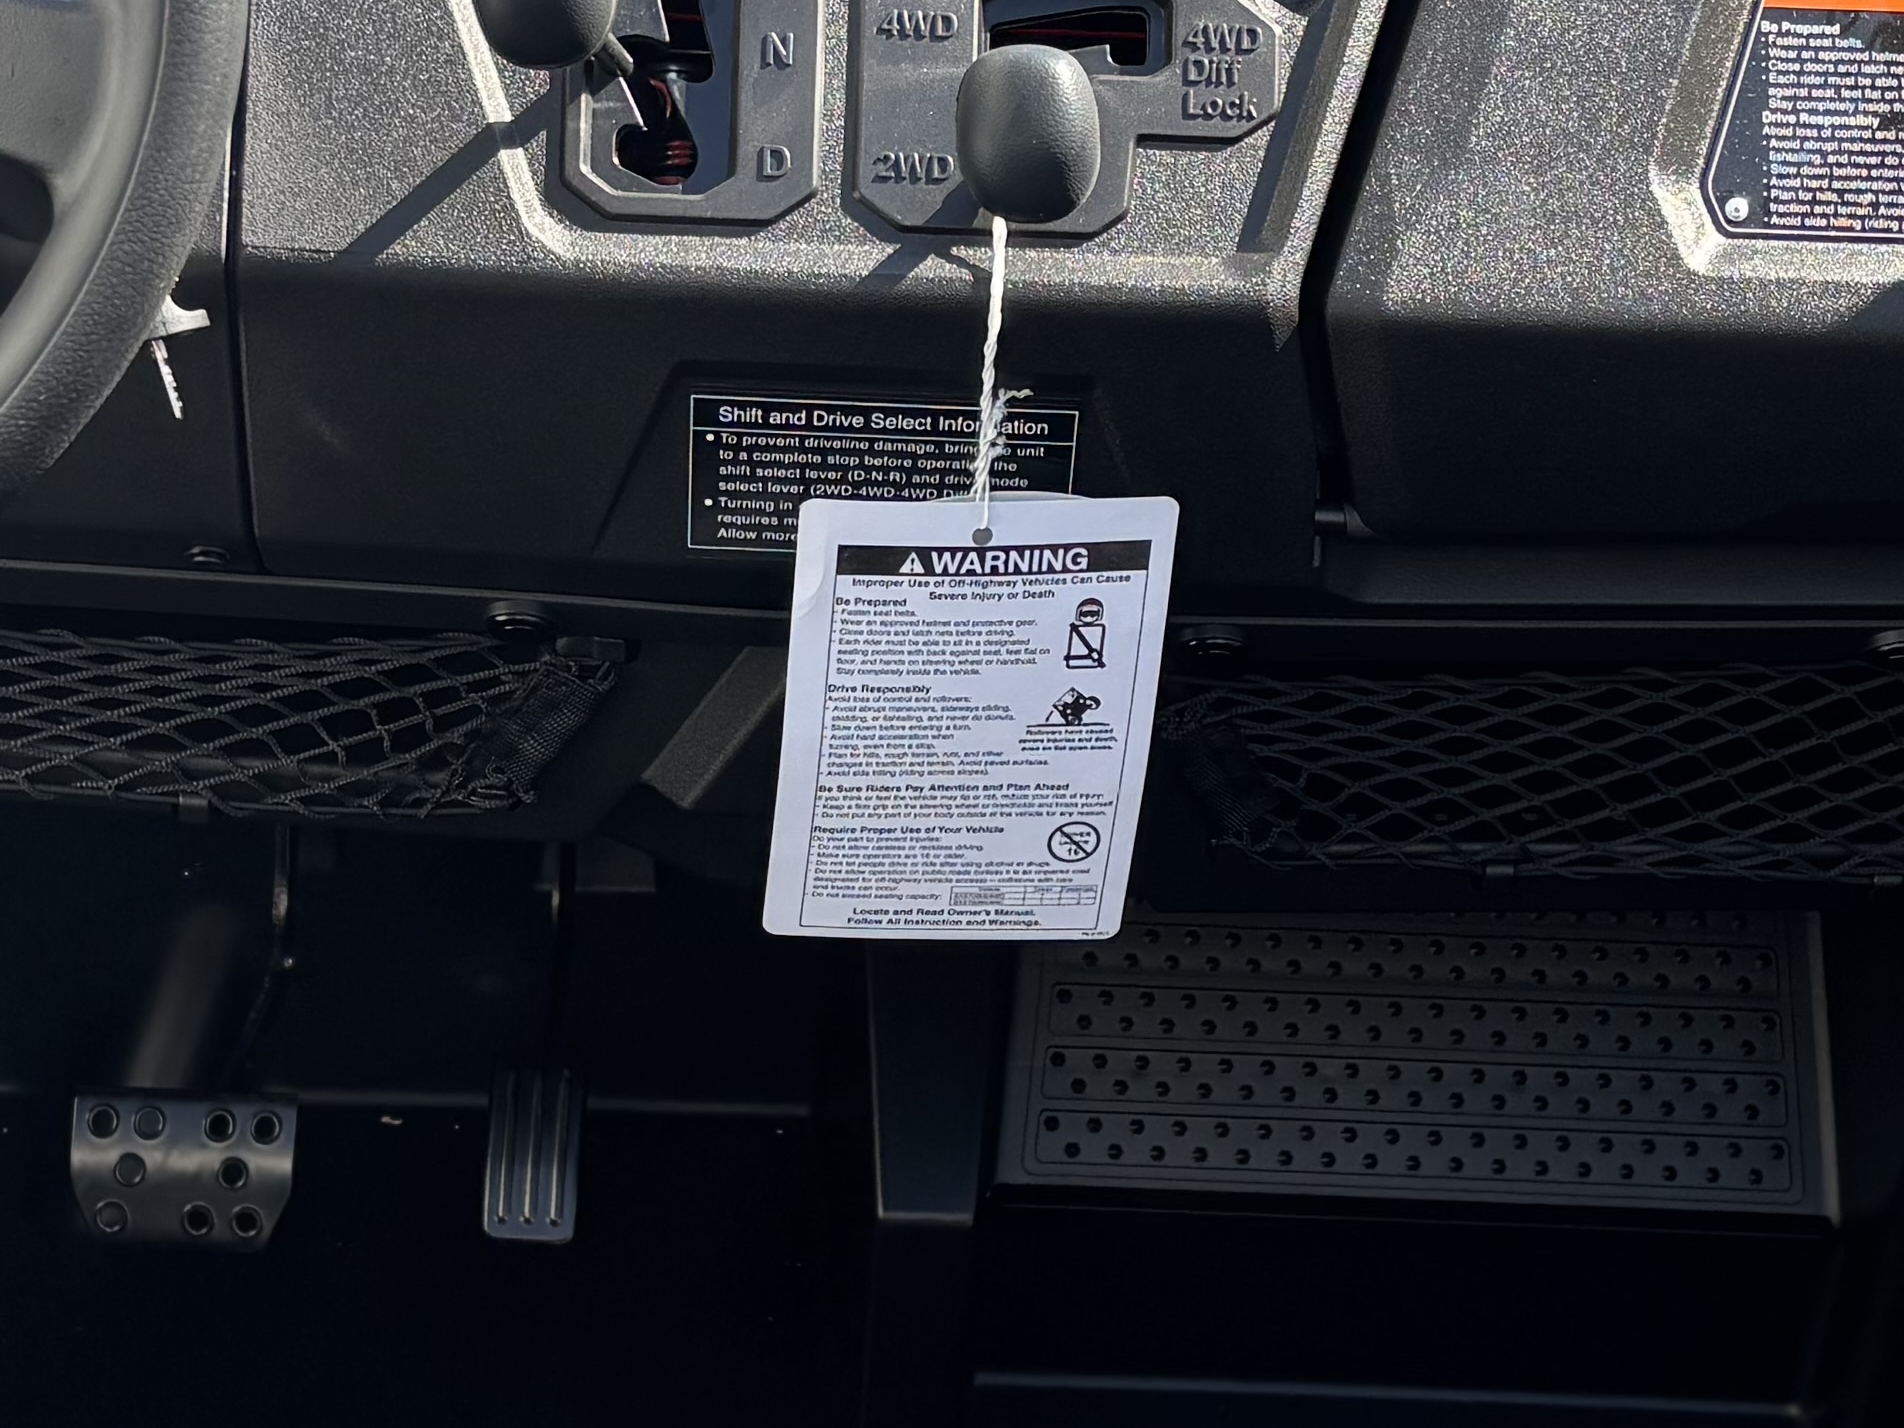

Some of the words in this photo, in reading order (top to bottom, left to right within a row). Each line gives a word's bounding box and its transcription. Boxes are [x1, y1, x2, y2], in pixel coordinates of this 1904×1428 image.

[876, 9, 959, 38] 4WD
[1761, 20, 1778, 32] Be
[1781, 21, 1840, 37] Prepared
[1182, 21, 1263, 51] 4WD
[1768, 36, 1806, 47] Fasten
[1808, 37, 1832, 47] seat
[1834, 37, 1865, 48] belts.
[765, 32, 794, 66] N
[1187, 54, 1243, 84] Diff
[1187, 88, 1258, 118] Lock
[1768, 100, 1793, 112] Stay
[1796, 100, 1855, 114] completely
[1858, 102, 1890, 112] inside
[1762, 112, 1796, 124] Drive
[1799, 113, 1879, 128] Responsibly
[762, 144, 792, 177] D
[873, 151, 955, 180] 2WD
[719, 407, 762, 424] Shift
[769, 408, 806, 425] and
[813, 410, 864, 428] Drive
[871, 412, 931, 430] Select
[939, 414, 1048, 434] Inforation
[721, 433, 737, 445] To
[742, 433, 799, 450] prevent
[804, 436, 869, 450] driveline
[1016, 444, 1044, 456] unit
[719, 448, 733, 460] to
[738, 451, 747, 460] a
[752, 449, 821, 466] complete
[827, 452, 859, 467] stop
[864, 453, 912, 467] before
[917, 455, 980, 472] operati
[994, 459, 1017, 471] the
[719, 464, 750, 476] shift
[755, 465, 800, 478] select
[805, 467, 841, 480] lever
[847, 468, 906, 485] (D-N-R)
[911, 471, 939, 483] and
[944, 472, 977, 485] driv
[718, 479, 762, 492] select
[767, 481, 803, 494] lever
[719, 497, 774, 511] Turning
[779, 498, 792, 509] in
[717, 514, 778, 528] requires
[717, 528, 757, 539] Allow
[930, 548, 1089, 575] WARNING
[852, 577, 904, 591] Improper
[908, 576, 930, 587] Use
[933, 576, 945, 587] of
[948, 574, 1018, 589] Off-Highway
[1070, 573, 1092, 584] Can
[1096, 572, 1131, 583] Cause
[835, 597, 850, 607] Be
[854, 597, 907, 609] Prepared
[928, 590, 967, 600] Severe
[970, 589, 1004, 602] Injury
[1006, 591, 1019, 599] or
[1022, 588, 1055, 598] Death
[827, 683, 857, 693] Drive
[861, 683, 931, 695] Responsibly
[818, 782, 833, 792] Be
[836, 782, 862, 792] Sure
[865, 782, 901, 792] Riders
[905, 782, 924, 794] Pay
[928, 781, 979, 791] Attention
[982, 781, 1003, 791] and
[1006, 781, 1030, 791] Plan
[1034, 781, 1069, 791] Ahead
[813, 824, 856, 836] Require
[860, 824, 897, 836] Proper
[900, 824, 921, 833] Use
[924, 823, 936, 833] of
[938, 823, 961, 833] Your
[965, 823, 1004, 833] Vehicle
[852, 907, 889, 917] Locate
[892, 907, 913, 916] and
[916, 906, 944, 916] Read
[947, 906, 991, 916] Owner's
[847, 916, 882, 926] Follow
[886, 916, 900, 926] All
[903, 916, 962, 926] Instruction
[965, 916, 986, 926] and
